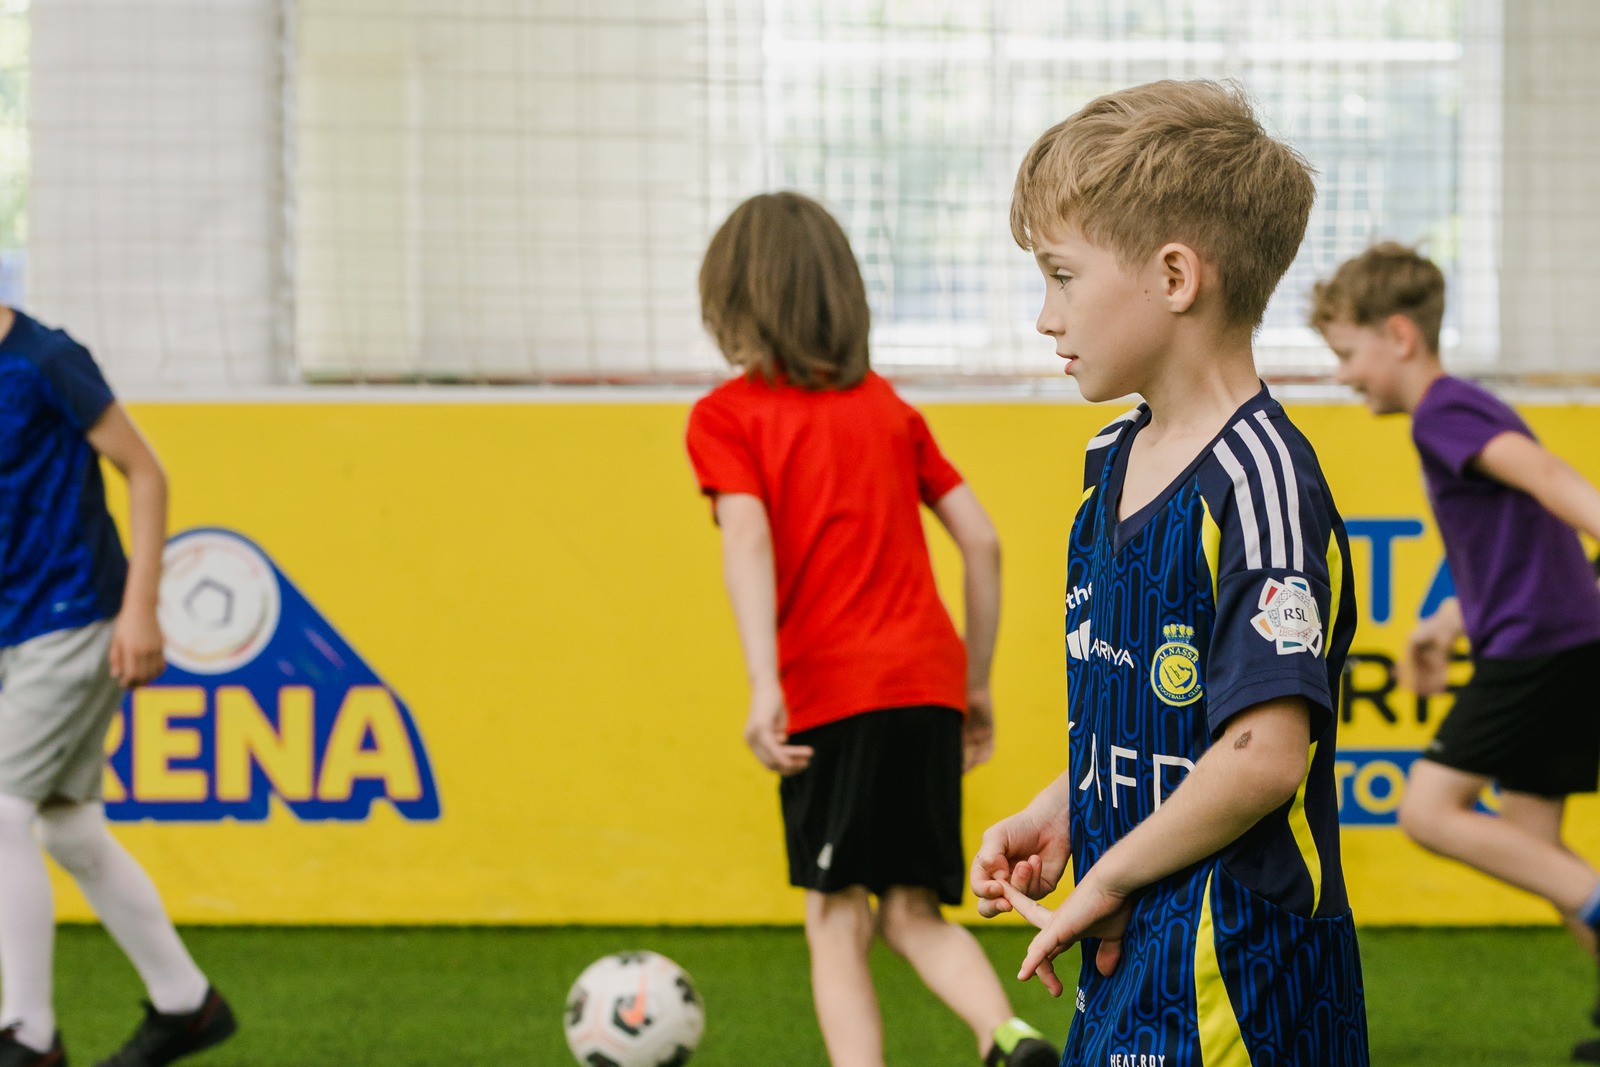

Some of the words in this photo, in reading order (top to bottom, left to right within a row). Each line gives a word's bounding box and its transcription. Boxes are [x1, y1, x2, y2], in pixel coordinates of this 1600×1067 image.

[1284, 607, 1308, 622] RSL
[1090, 638, 1134, 669] ARYA
[1169, 647, 1198, 663] NASSR
[1158, 684, 1186, 699] FOOTBALL
[1187, 684, 1202, 698] CLUB
